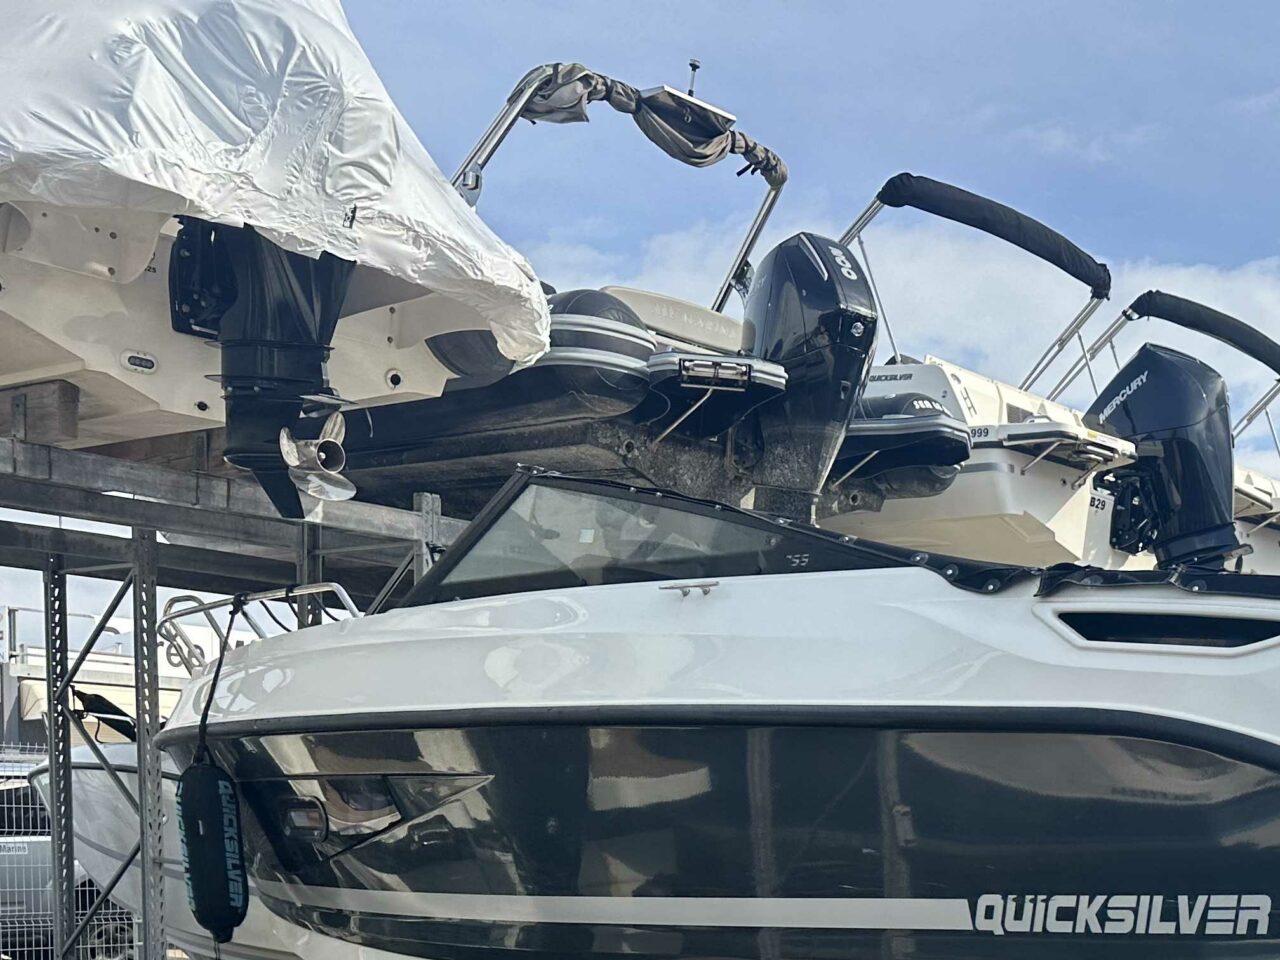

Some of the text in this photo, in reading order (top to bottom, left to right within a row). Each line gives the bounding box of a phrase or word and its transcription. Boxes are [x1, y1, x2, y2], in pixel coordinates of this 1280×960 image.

[1098, 370, 1149, 425] MERCURY
[970, 427, 989, 439] 999
[1089, 496, 1106, 511] B29
[217, 779, 247, 911] QUICKSILVER
[974, 893, 1273, 936] QUICKSILVER
